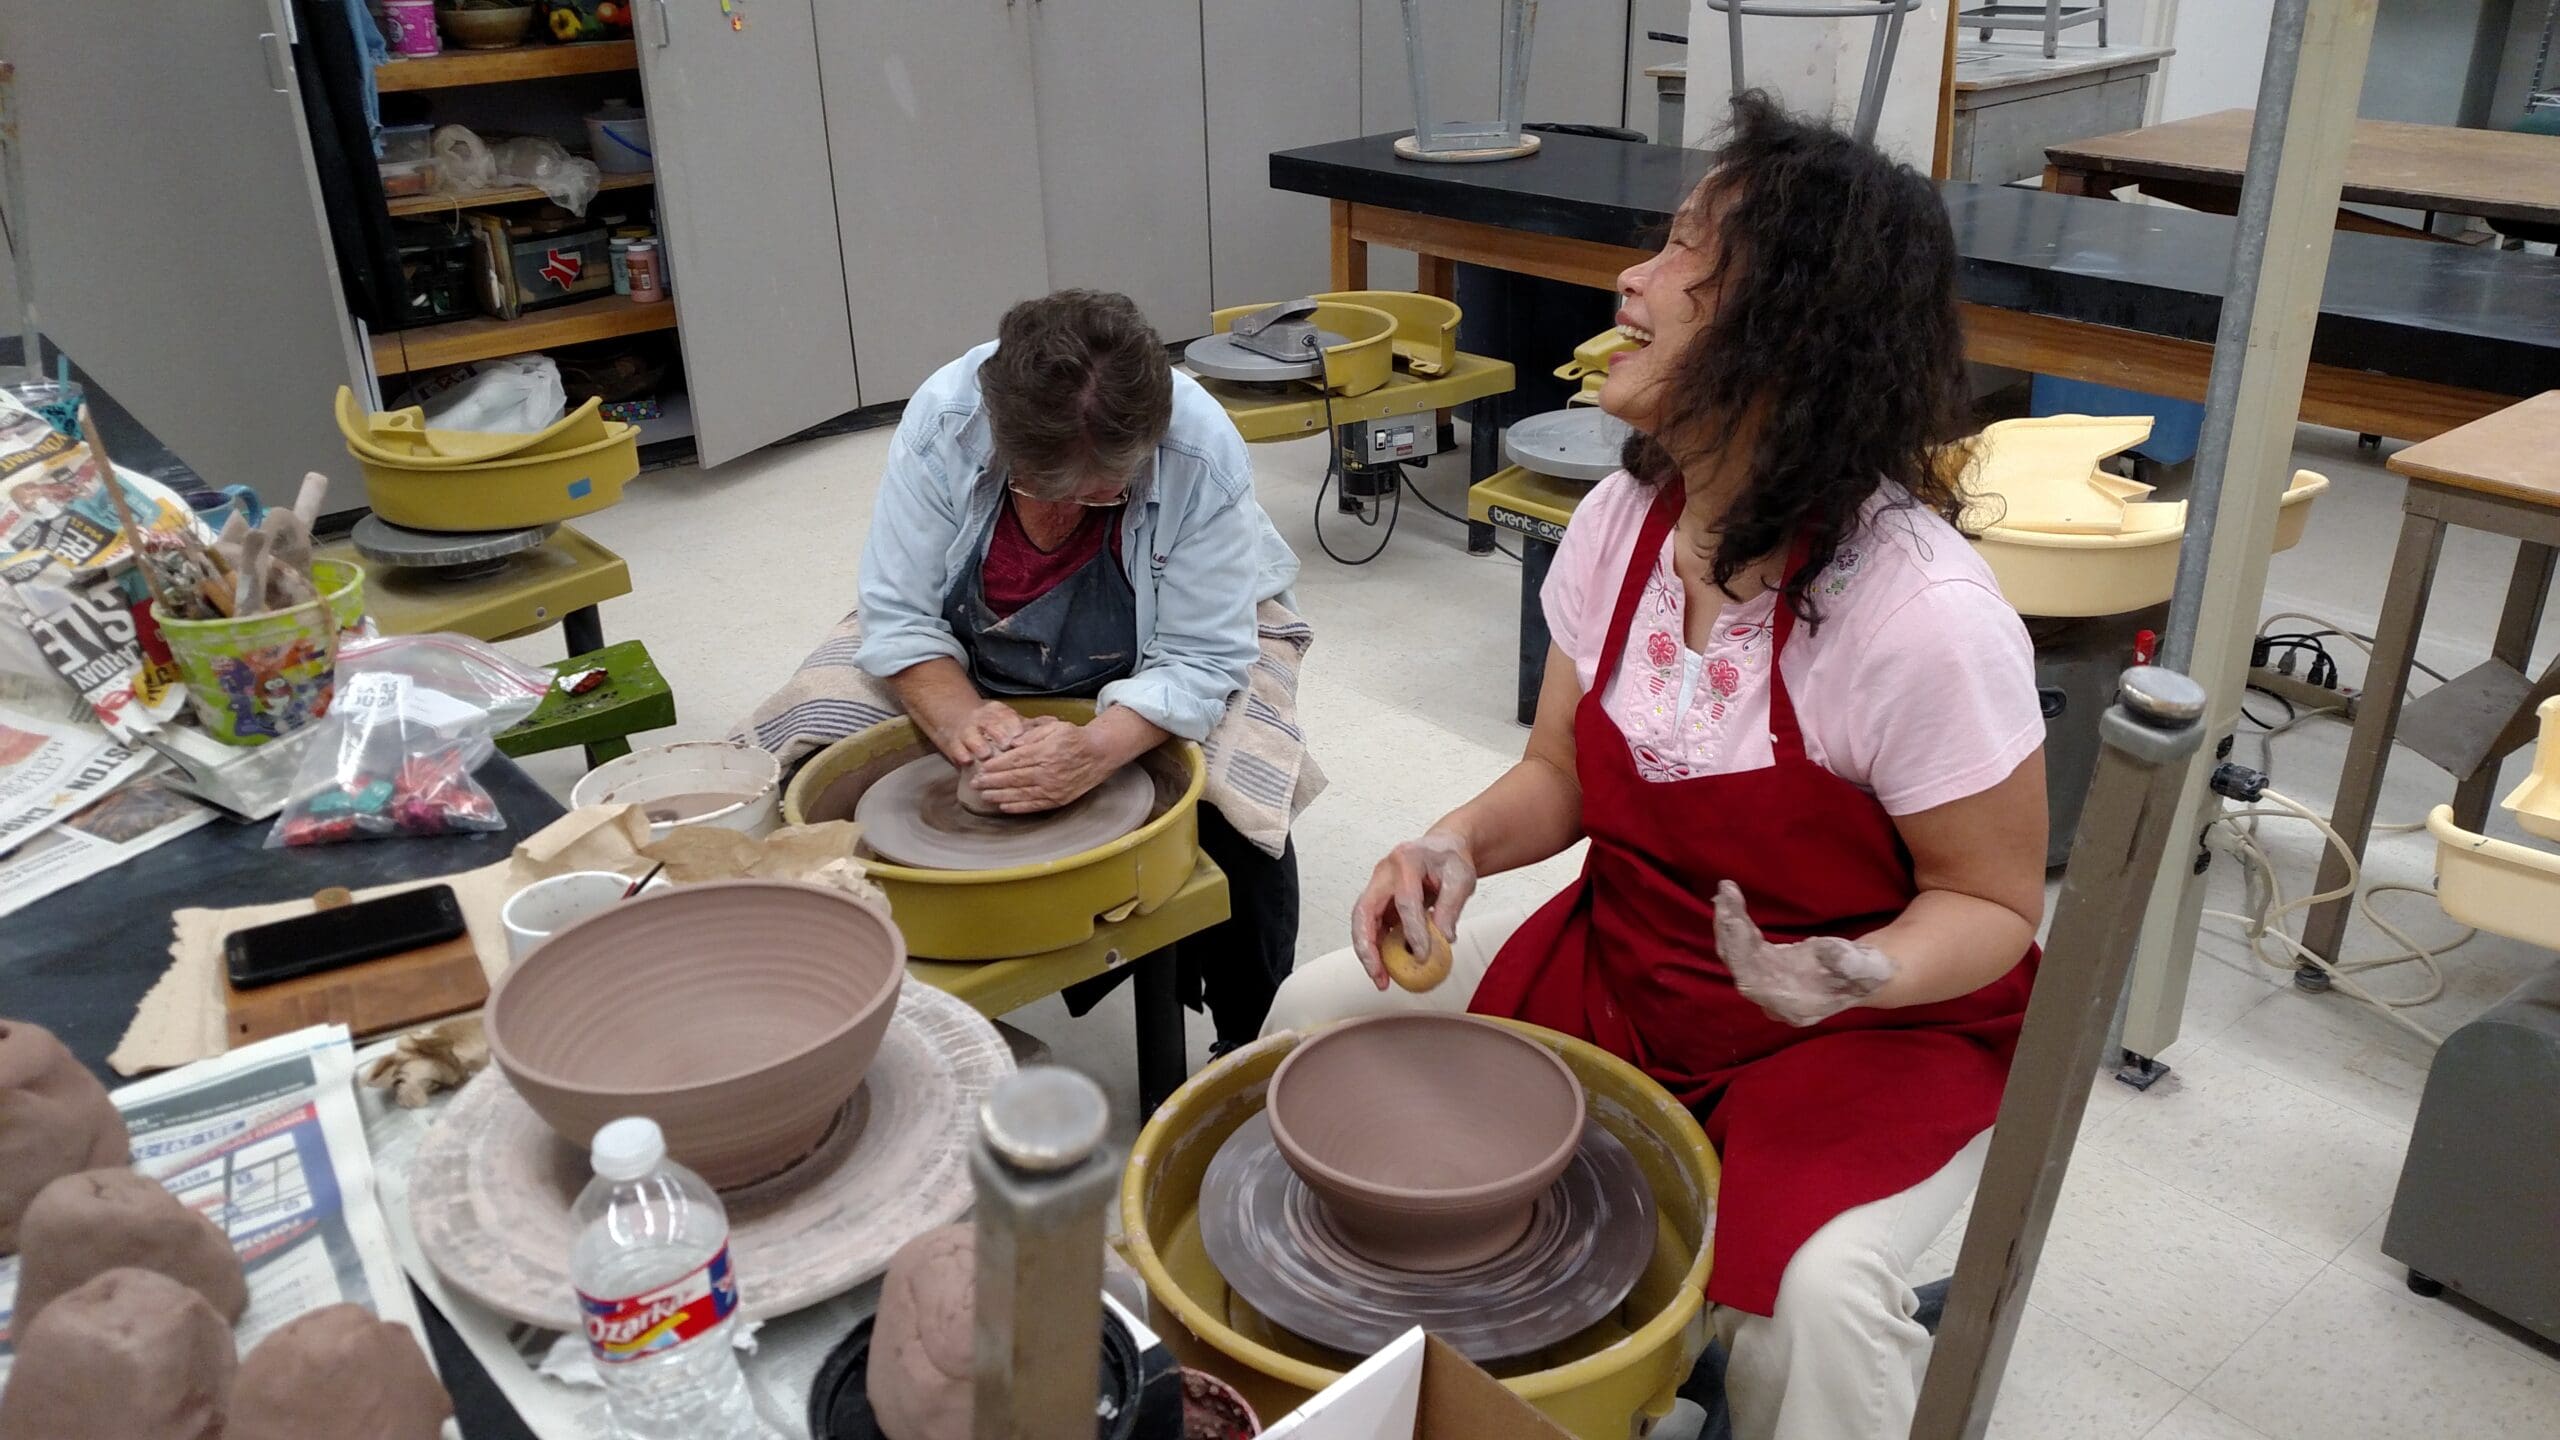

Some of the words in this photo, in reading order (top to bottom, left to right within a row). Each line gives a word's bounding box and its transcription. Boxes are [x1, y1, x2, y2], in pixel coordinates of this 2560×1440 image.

[1493, 505, 1532, 531] brent
[54, 527, 98, 565] FRE
[32, 580, 137, 676] SLE
[65, 742, 134, 792] STON
